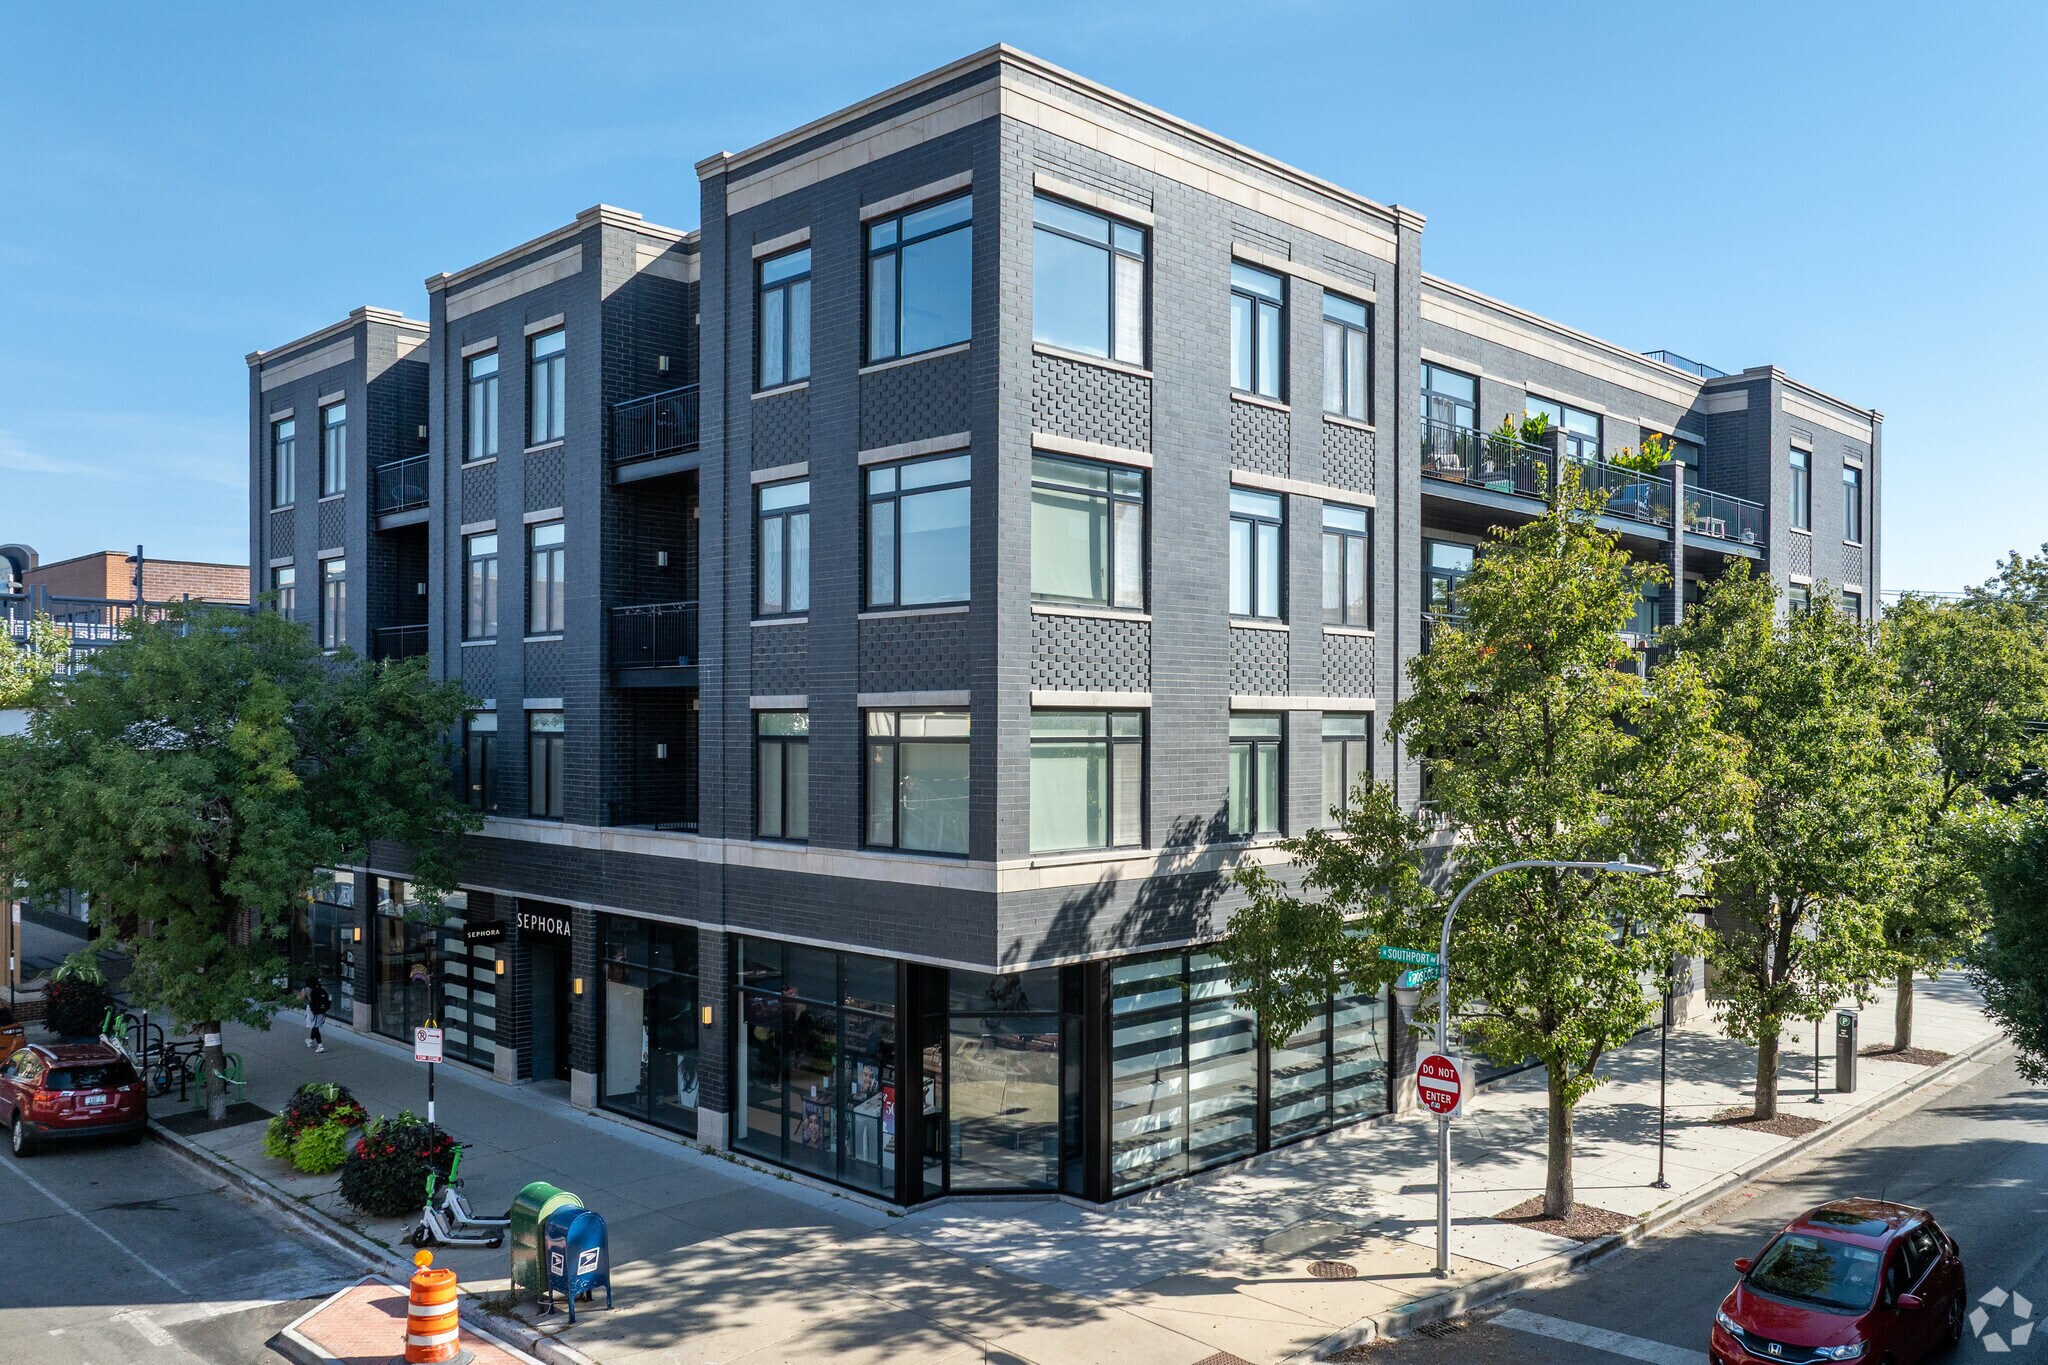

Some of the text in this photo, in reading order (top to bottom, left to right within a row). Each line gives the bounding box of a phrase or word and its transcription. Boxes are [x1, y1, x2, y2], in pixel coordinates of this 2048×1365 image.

[517, 912, 571, 937] SEPHORA
[467, 929, 500, 939] SEPHORA
[1387, 948, 1430, 964] SOUTHPORT
[1411, 967, 1435, 985] ROSCOE
[1423, 1064, 1454, 1079] DO NOT
[1426, 1090, 1452, 1104] ENTER
